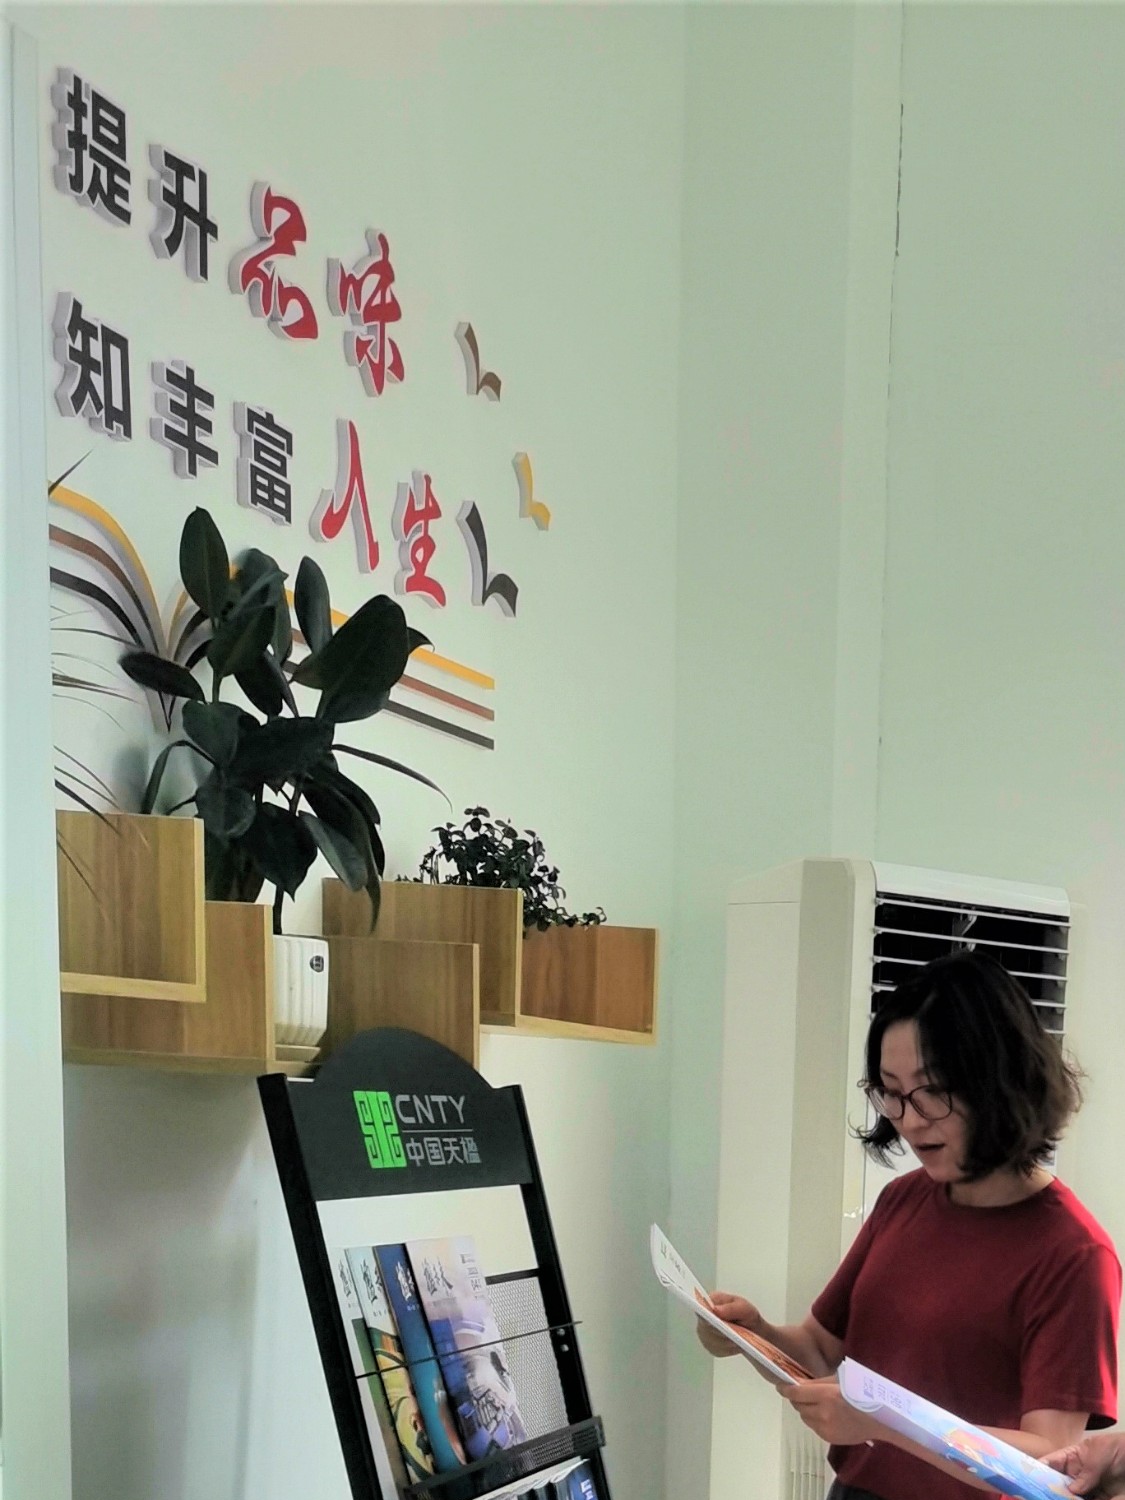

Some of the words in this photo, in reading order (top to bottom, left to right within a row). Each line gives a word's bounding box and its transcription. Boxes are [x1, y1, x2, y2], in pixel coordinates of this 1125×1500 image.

[60, 69, 405, 396] 提升品味
[62, 296, 446, 608] 知丰富人生
[394, 1093, 466, 1124] CNTY
